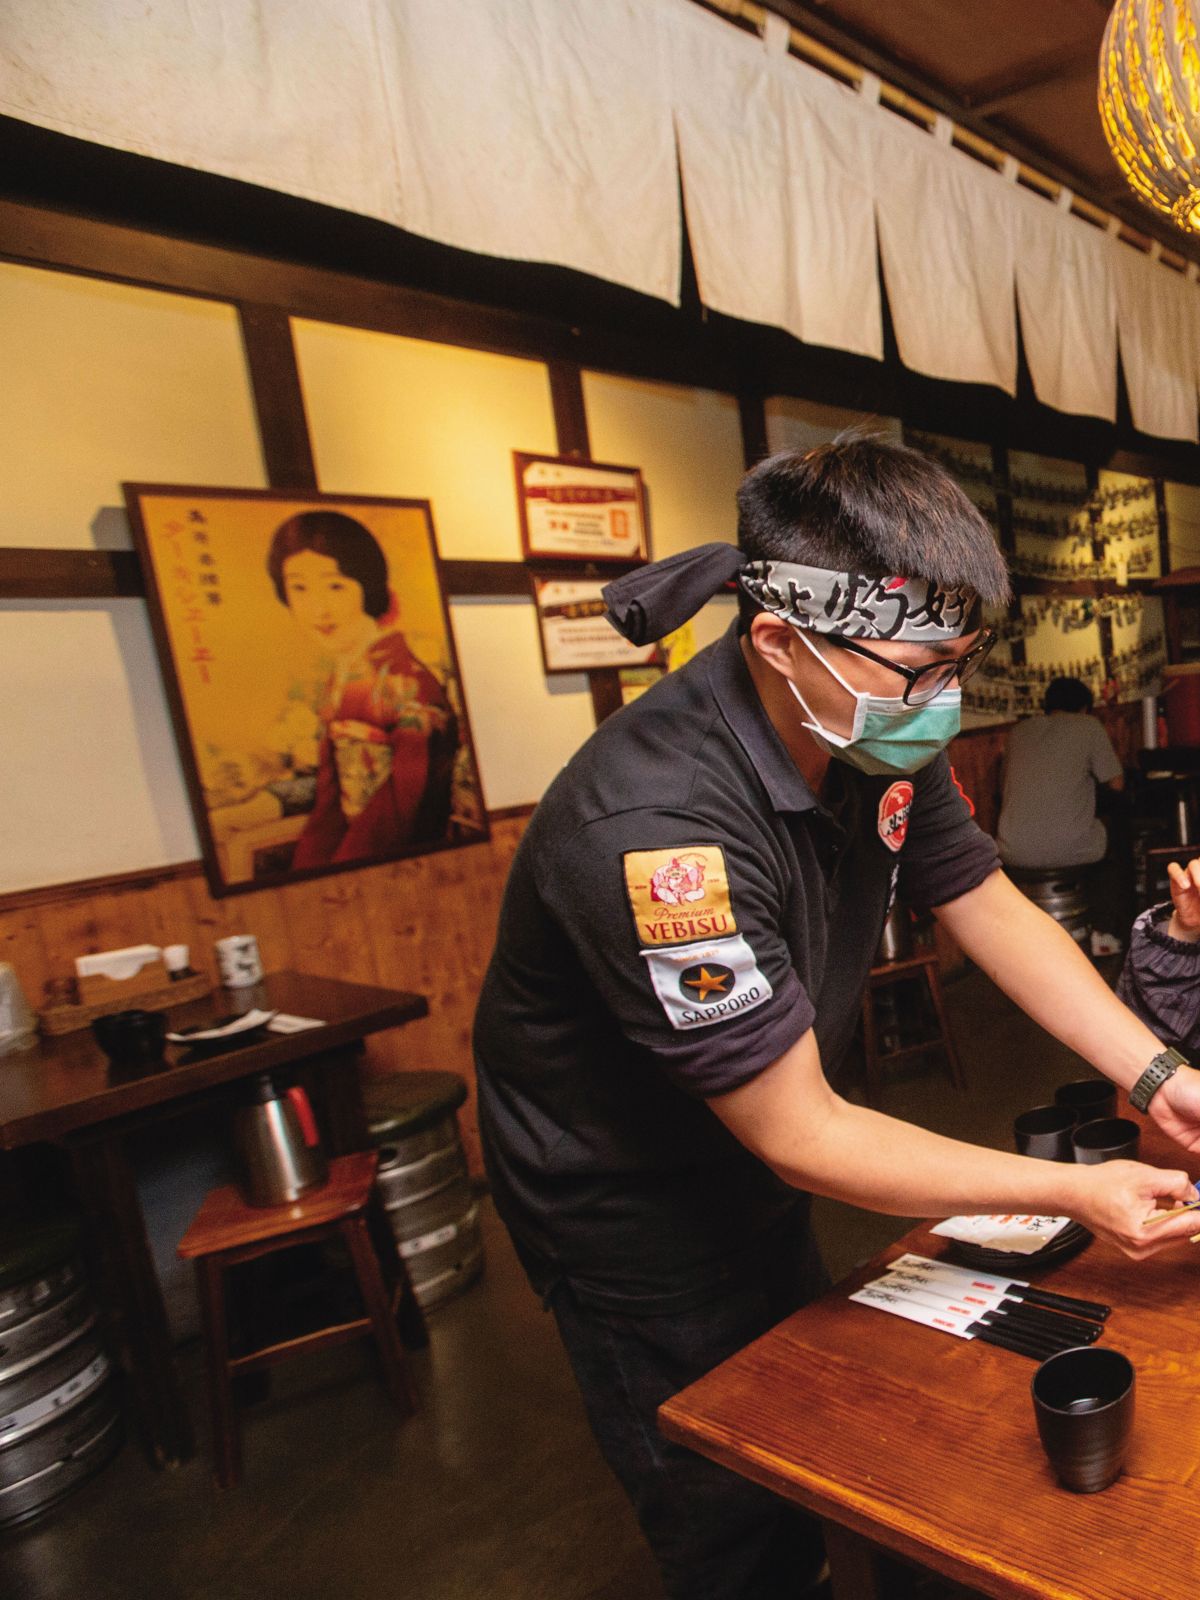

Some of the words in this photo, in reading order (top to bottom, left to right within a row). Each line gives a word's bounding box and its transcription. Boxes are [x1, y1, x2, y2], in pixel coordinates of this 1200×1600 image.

[653, 906, 715, 921] Premium
[644, 914, 728, 940] YEBISU
[681, 986, 761, 1024] SAPPORO
